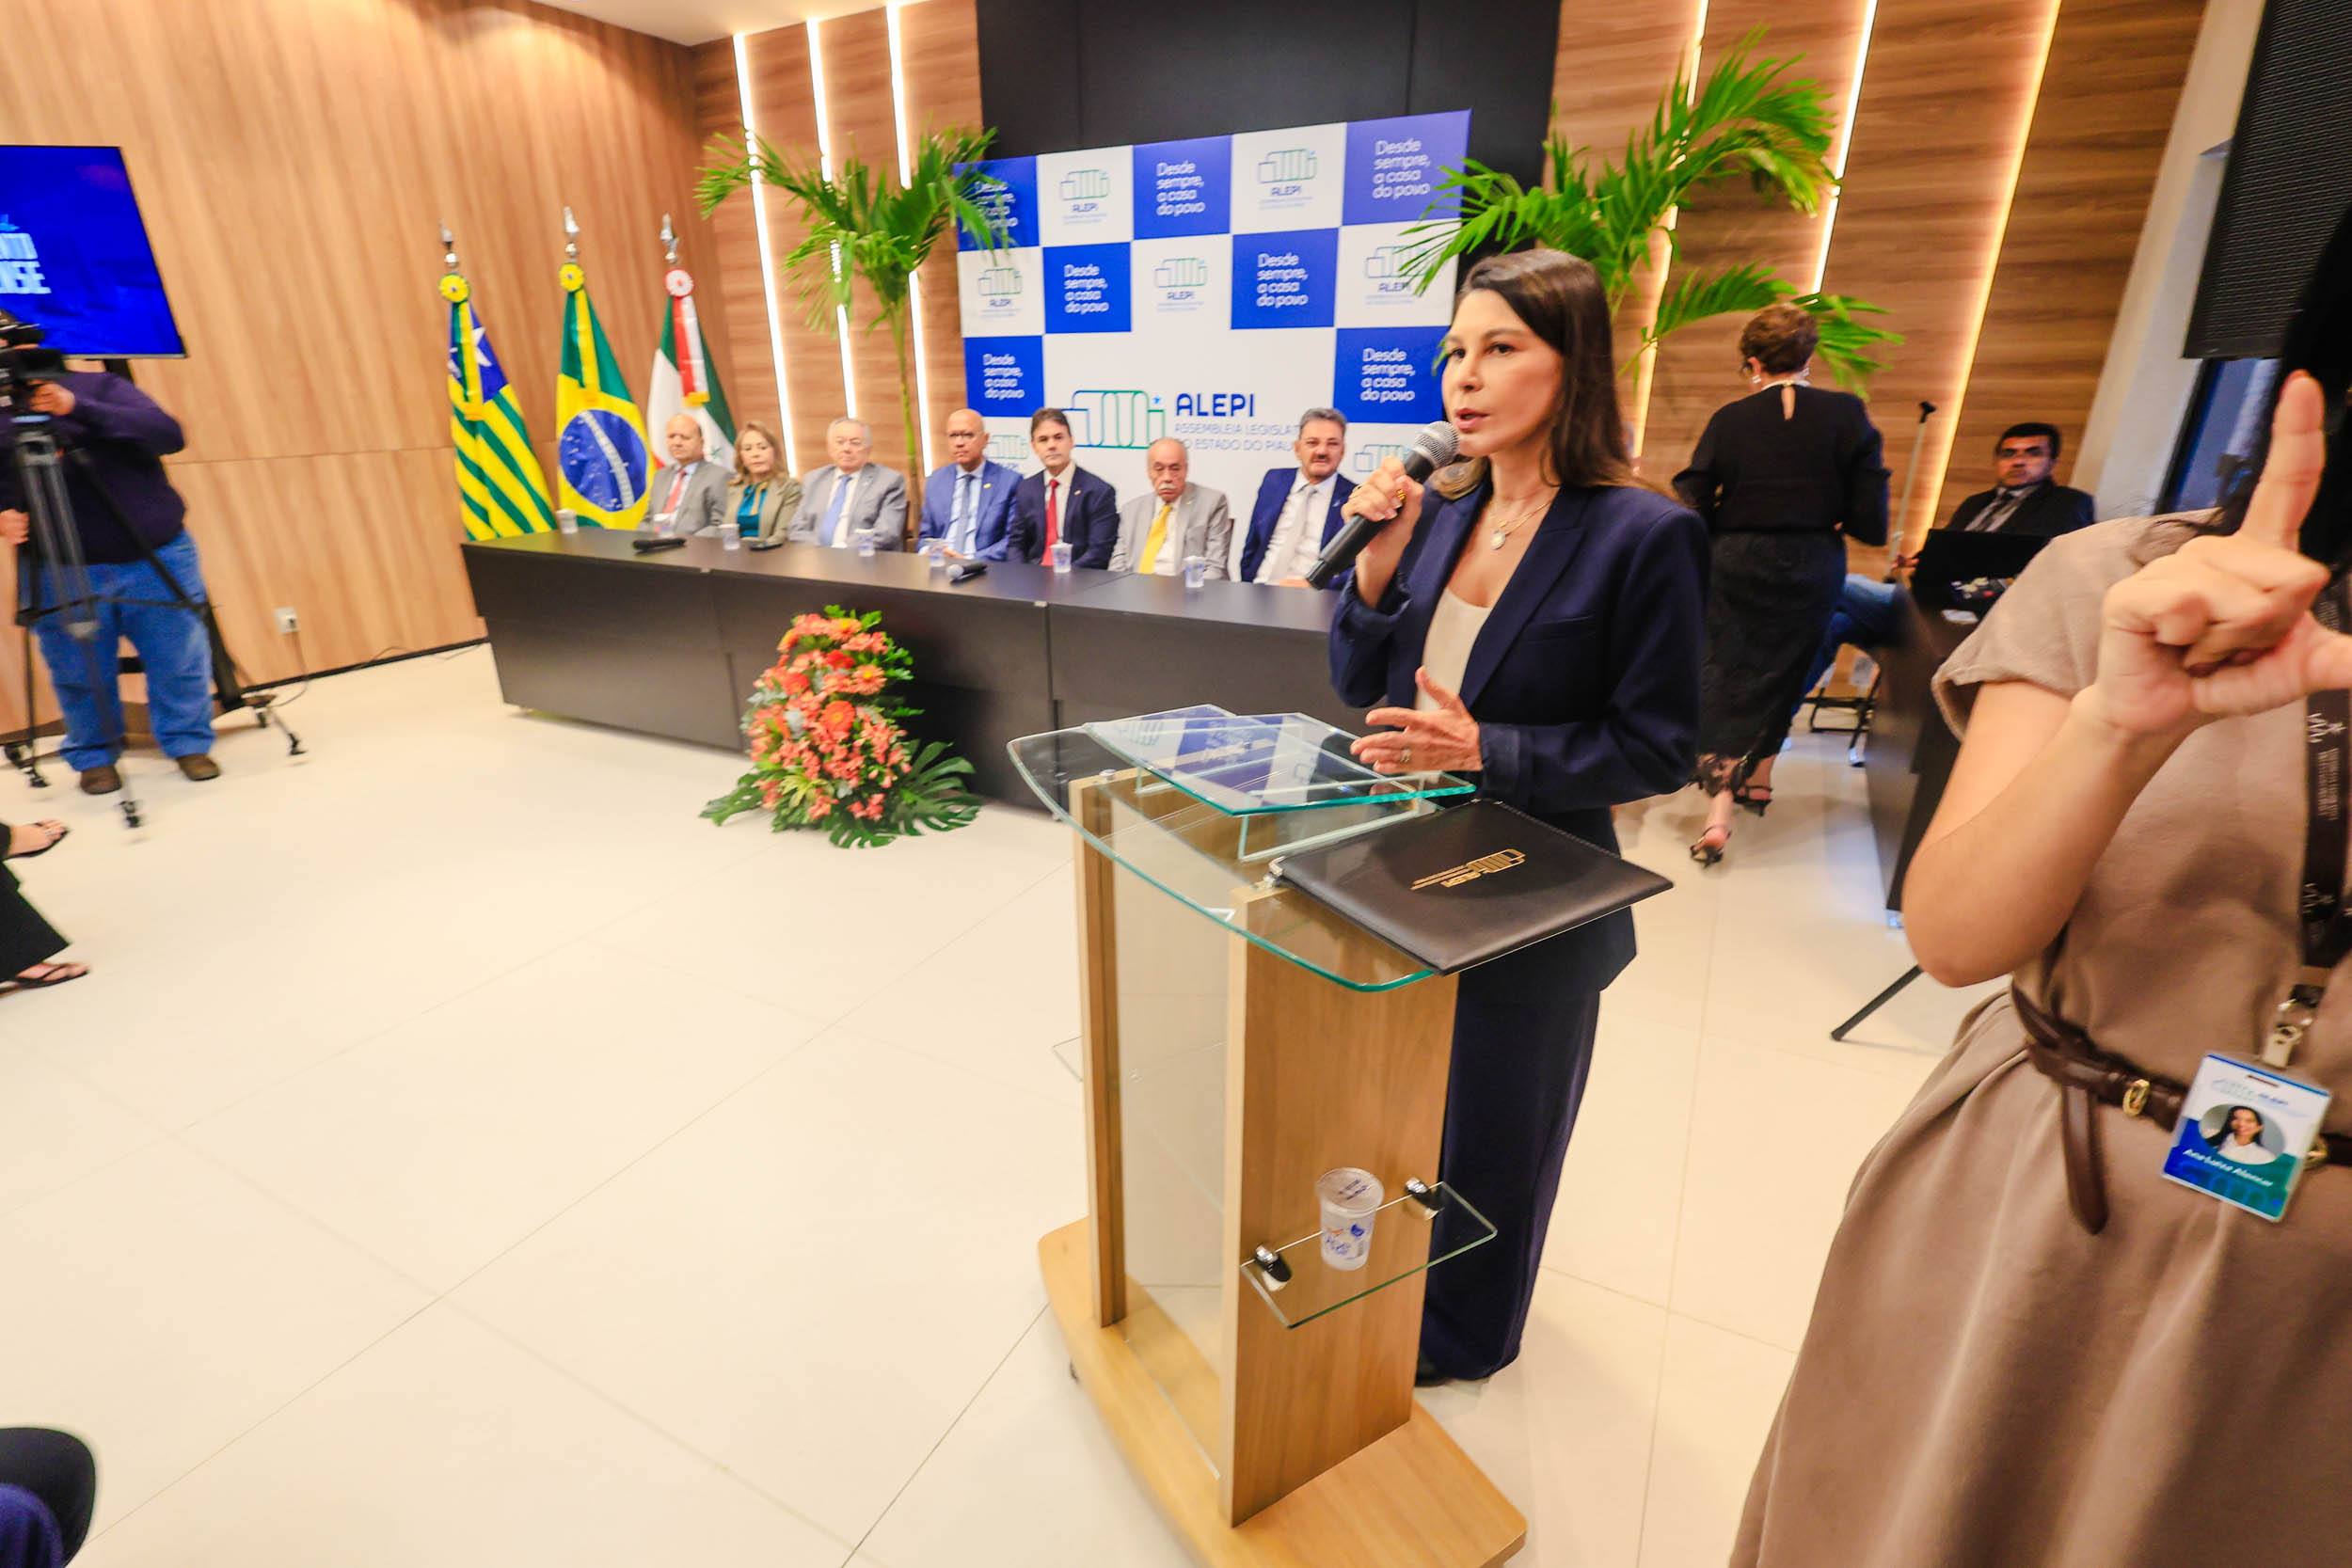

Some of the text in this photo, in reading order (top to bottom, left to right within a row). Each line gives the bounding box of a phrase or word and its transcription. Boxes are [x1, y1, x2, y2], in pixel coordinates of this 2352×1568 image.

[1375, 137, 1422, 155] Desde
[1156, 160, 1196, 176] Desde
[1374, 154, 1430, 169] sempre,
[1156, 176, 1204, 189] sempre,
[1374, 170, 1421, 183] a casa
[1157, 189, 1197, 202] a casa
[1373, 183, 1430, 199] do povo
[1156, 202, 1205, 216] do povo
[1258, 253, 1299, 267] Desde
[1064, 263, 1100, 277] Desde
[1257, 268, 1309, 282] sempre,
[1064, 278, 1108, 290] sempre,
[1257, 282, 1300, 293] a casa
[1074, 291, 1102, 301] casa
[1257, 293, 1309, 309] do povo
[1065, 301, 1109, 315] do povo
[983, 354, 1015, 365] Desde
[1363, 348, 1407, 361] Desde
[1362, 364, 1415, 377] sempre,
[993, 378, 1018, 388] casa
[1361, 378, 1407, 388] a casa
[999, 389, 1025, 401] povo
[1360, 388, 1415, 403] do povo
[1176, 393, 1254, 417] ALEPI
[1175, 422, 1301, 436] ASSEMBLEIA LEGISLAT
[1197, 439, 1241, 451] ESTADO
[1244, 440, 1263, 451] DO
